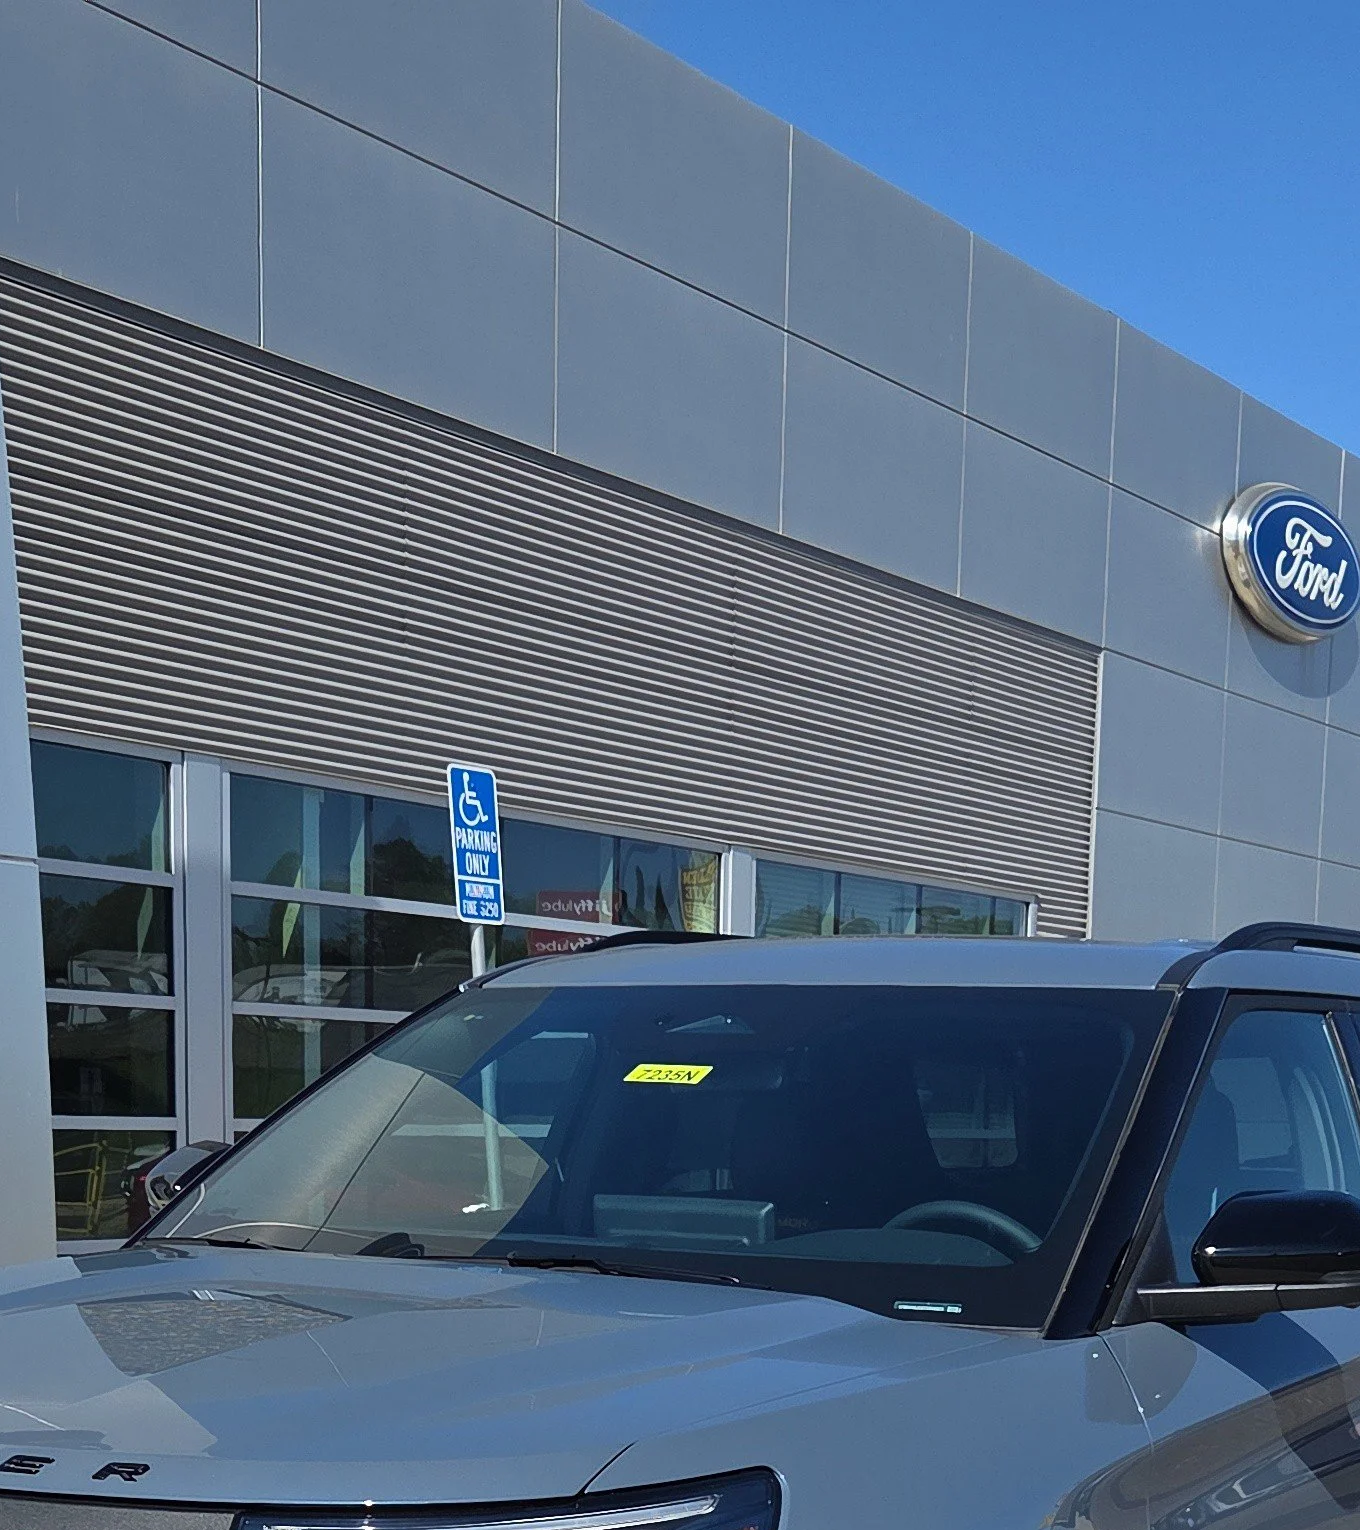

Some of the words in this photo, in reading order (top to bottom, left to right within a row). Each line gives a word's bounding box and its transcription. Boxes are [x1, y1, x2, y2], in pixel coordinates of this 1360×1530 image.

[1275, 517, 1348, 610] Ford
[455, 826, 498, 854] PARKING
[465, 852, 490, 876] ONLY
